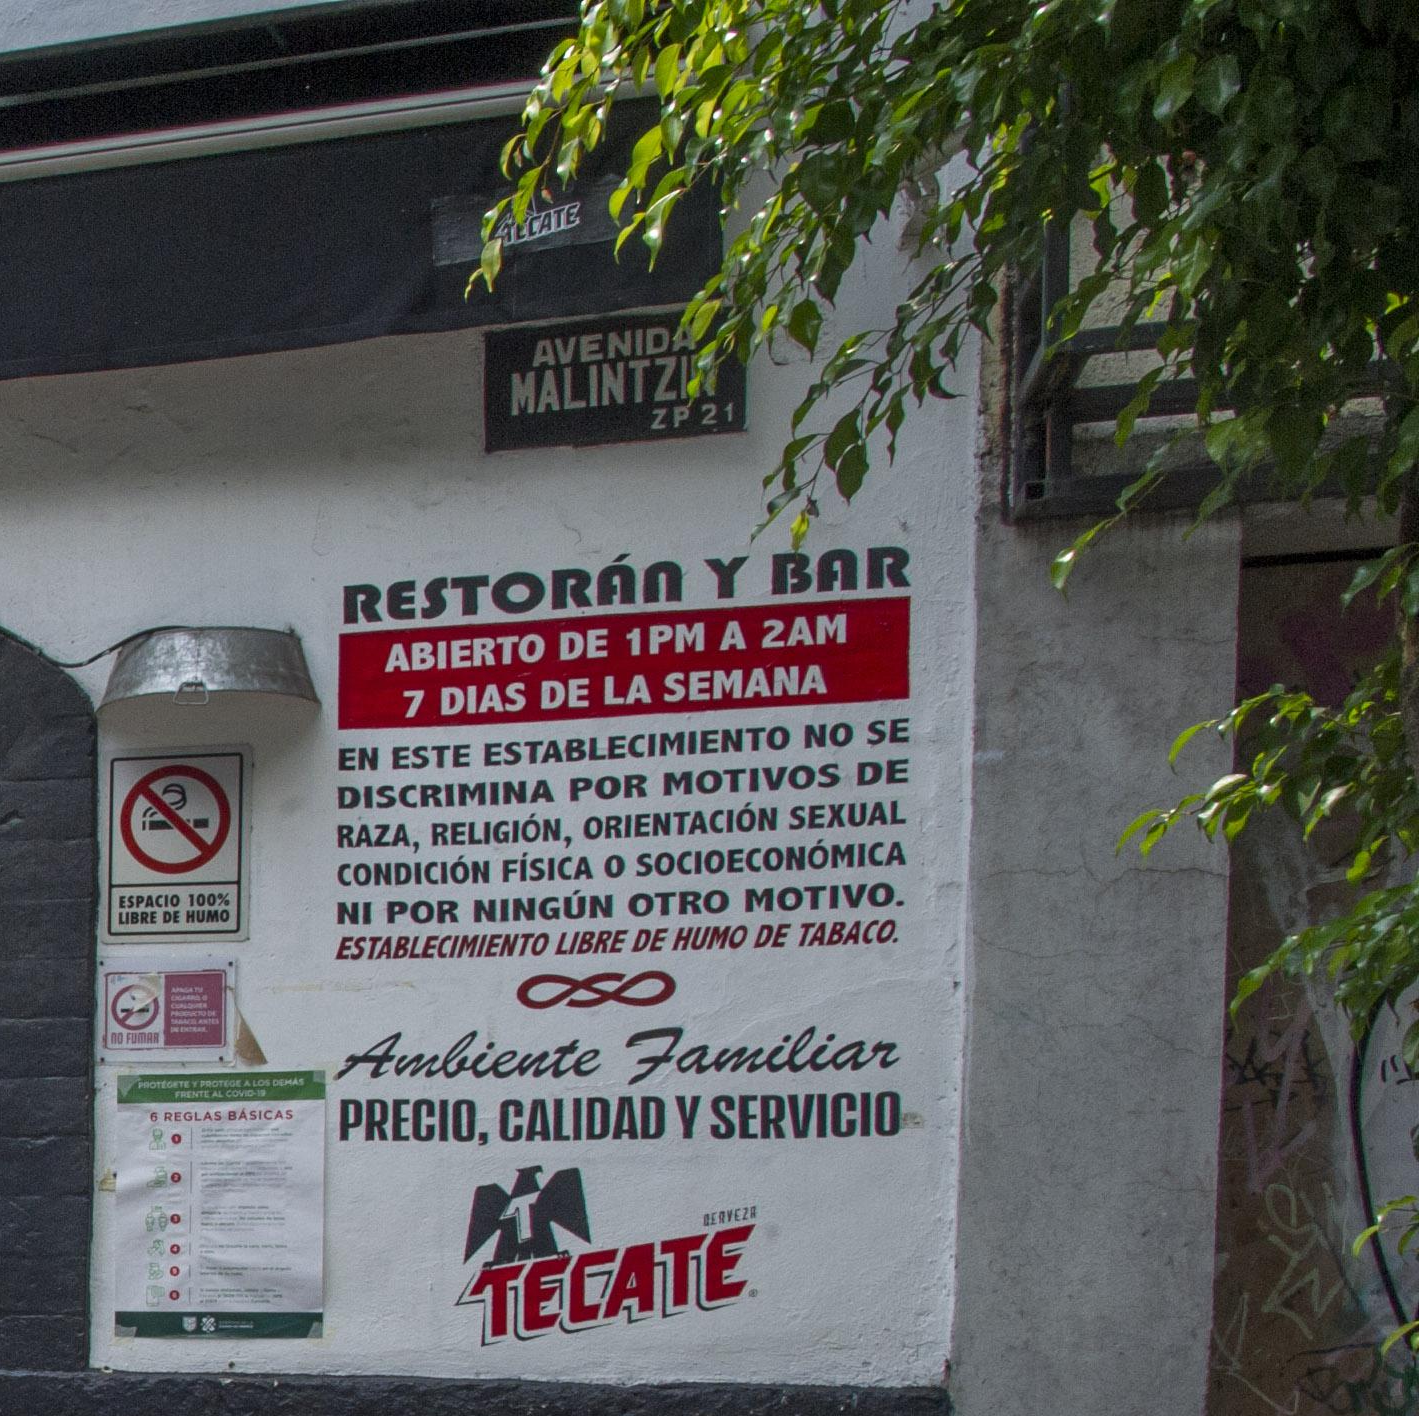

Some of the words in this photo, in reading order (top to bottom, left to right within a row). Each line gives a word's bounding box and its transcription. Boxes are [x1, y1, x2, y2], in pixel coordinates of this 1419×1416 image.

[532, 326, 696, 367] AVENIDA
[701, 402, 735, 424] 21
[341, 552, 683, 625] RESTORÁN
[704, 555, 749, 600] Y
[770, 545, 912, 597] BAR
[384, 633, 546, 674] ABIERTO
[559, 628, 610, 660] DE
[625, 621, 706, 657] 1PM
[720, 621, 747, 651] A
[761, 613, 849, 650] 2AM
[402, 689, 424, 719] 7
[439, 681, 527, 717] DIAS
[539, 677, 588, 710] DE
[603, 673, 653, 706] LA
[662, 664, 828, 703] SEMANA
[337, 746, 380, 773] EN
[391, 742, 472, 770] ESTE
[482, 725, 792, 767] ESTABLECIMIENTO
[803, 721, 854, 750] NO
[865, 717, 911, 747] SE
[337, 777, 554, 811] DISCRIMINA
[568, 773, 649, 801] POR
[663, 761, 841, 797] MOTIVOS
[855, 757, 910, 788] DE
[336, 822, 421, 854] RAZA,
[429, 810, 574, 850] RELIGIÓN,
[582, 799, 779, 842] ORIENTACIÓN
[788, 799, 907, 832] SEXUAL
[336, 852, 492, 888] CONDICIÓN
[502, 850, 593, 884] FÍSICA
[603, 854, 627, 880] O
[635, 836, 907, 879] SOCIOECONÓMICA
[118, 894, 181, 909] ESPACIO
[188, 893, 230, 908] 100%
[118, 909, 158, 925] LIBRE
[162, 909, 181, 925] DE
[186, 909, 230, 924] HUMO
[336, 899, 375, 927] NI
[385, 896, 459, 925] POR
[472, 886, 615, 923] NINGÚN
[627, 888, 731, 919] OTRO
[744, 881, 905, 916] MOTIVO.
[335, 931, 550, 962] ESTABLECIMIENTO
[555, 927, 627, 957] LIBRE
[632, 926, 667, 953] DE
[672, 922, 749, 952] HUMO
[753, 922, 788, 950] DE
[797, 917, 900, 948] TABACO.
[110, 1032, 123, 1045] NO
[126, 1032, 160, 1045] FUMAR
[334, 1029, 602, 1081] Ambiente
[624, 1025, 902, 1086] Familiar
[174, 1090, 210, 1099] FRENTE
[212, 1090, 224, 1099] AL
[199, 1080, 242, 1089] PROTEGE
[242, 1079, 250, 1087] A
[252, 1079, 271, 1088] LOS
[272, 1077, 305, 1087] DEMÁS
[149, 1111, 159, 1122] 6
[164, 1110, 223, 1122] REGLAS
[227, 1107, 295, 1121] BÁSICAS
[339, 1096, 490, 1147] PRECIO,
[498, 1094, 666, 1143] CALIDAD
[676, 1094, 703, 1140] Y
[709, 1089, 902, 1142] SERVICIO
[454, 1223, 758, 1348] TECATE
